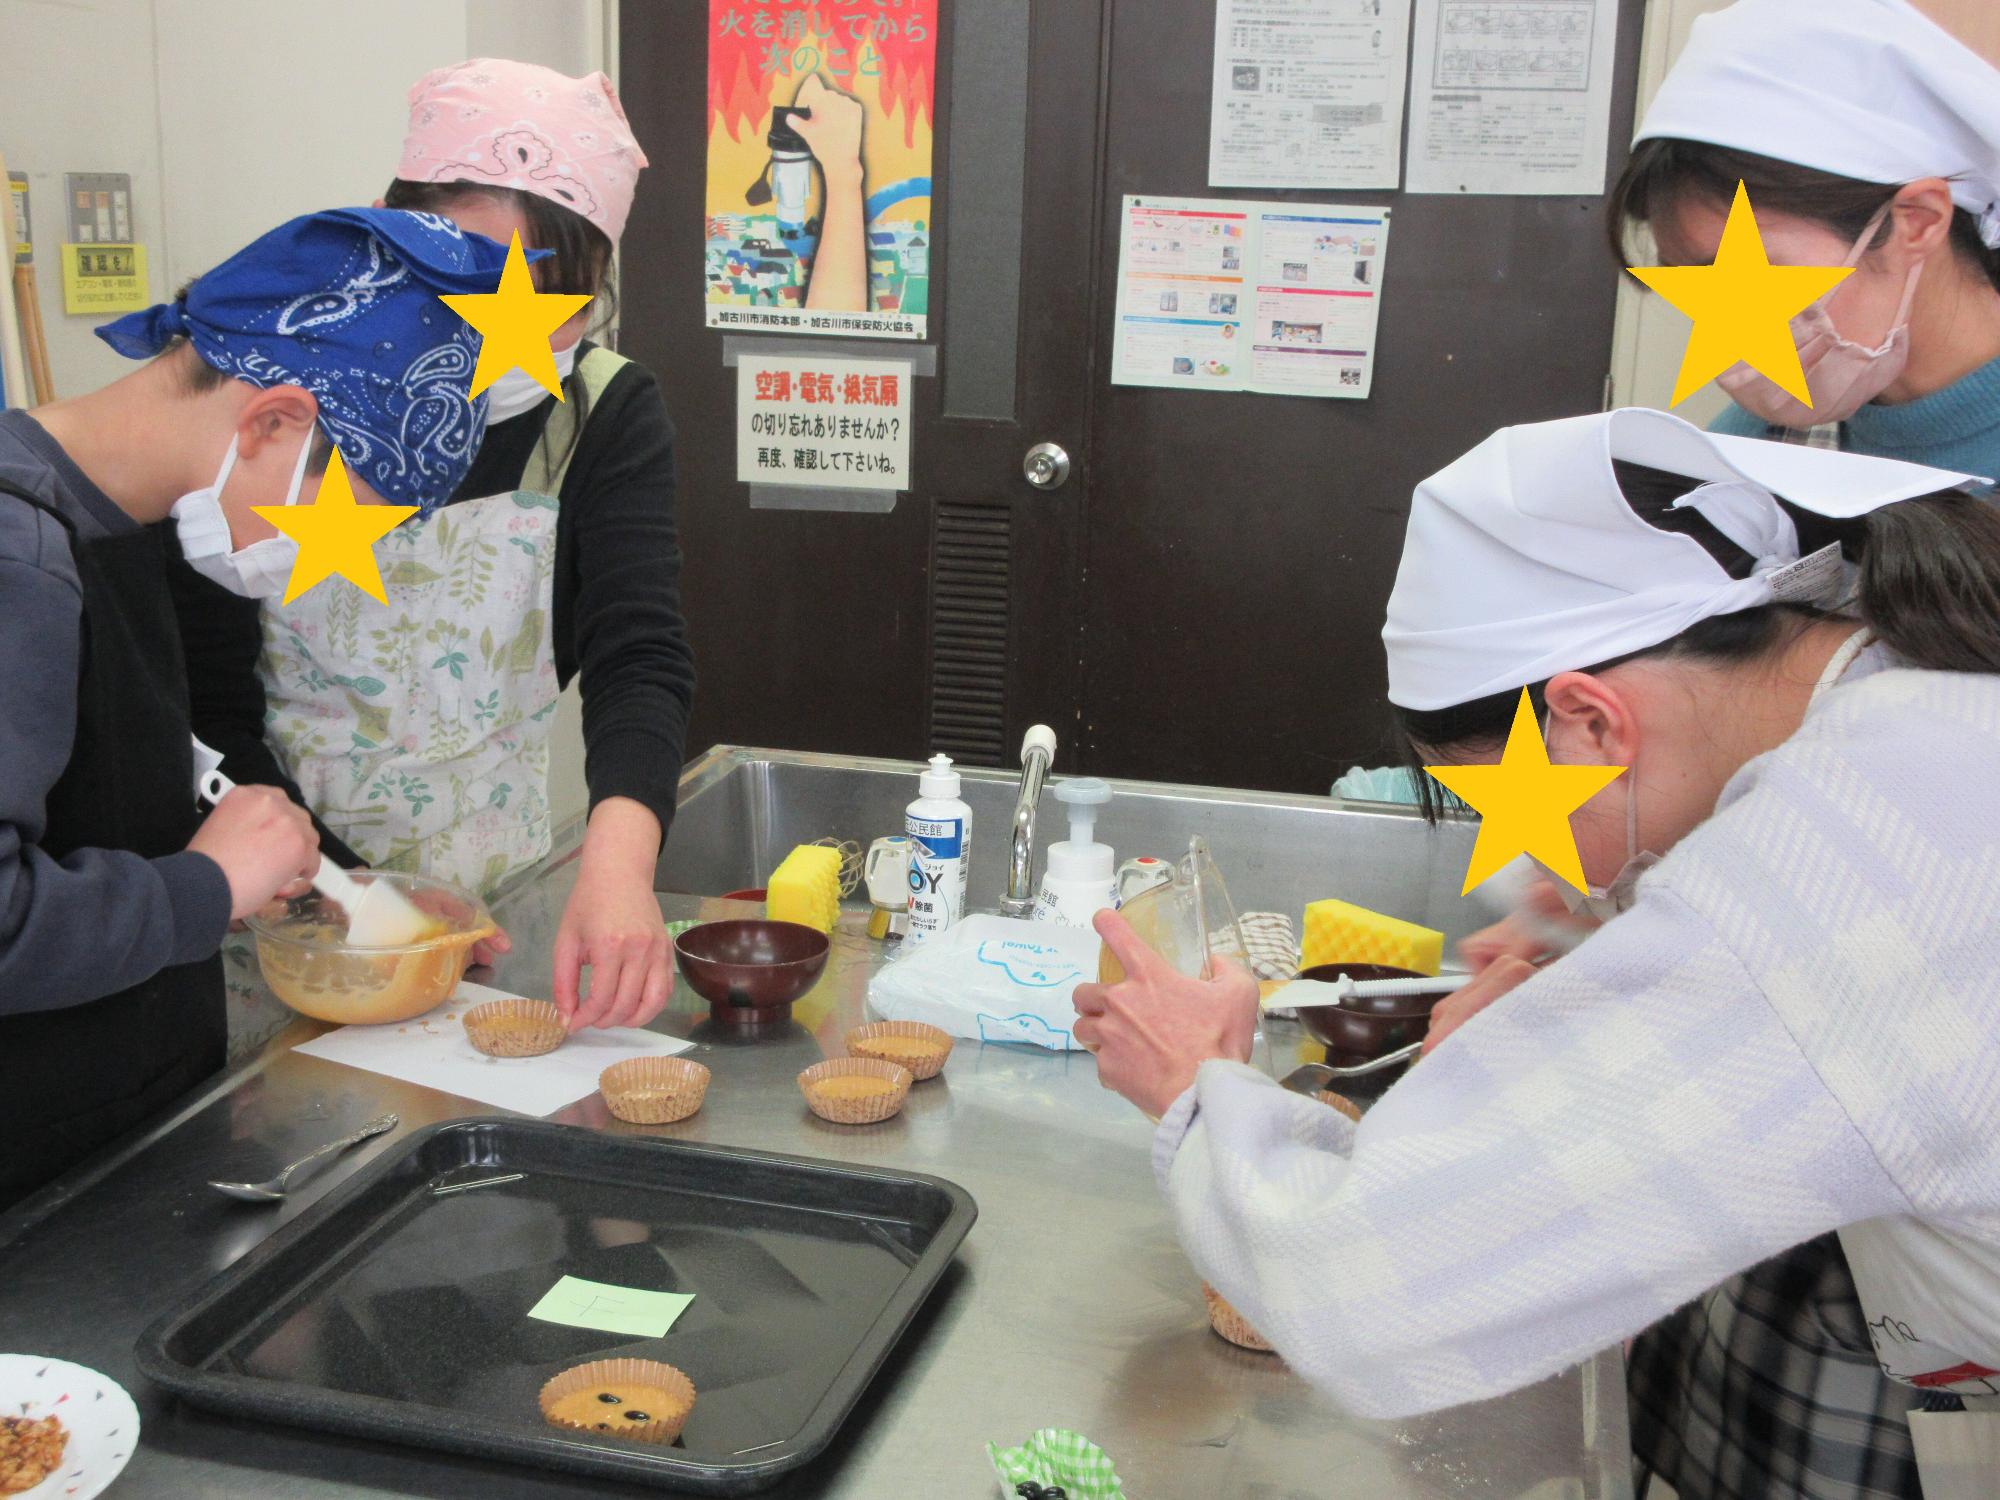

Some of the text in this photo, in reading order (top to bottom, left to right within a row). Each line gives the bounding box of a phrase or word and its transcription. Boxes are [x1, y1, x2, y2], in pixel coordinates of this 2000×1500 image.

[718, 9, 927, 43] 火を消してから
[759, 42, 881, 76] 次のこと
[751, 412, 900, 441] の切り忘れありませんか？
[757, 447, 896, 475] 再度、確認して下さいね。
[908, 869, 944, 894] OY
